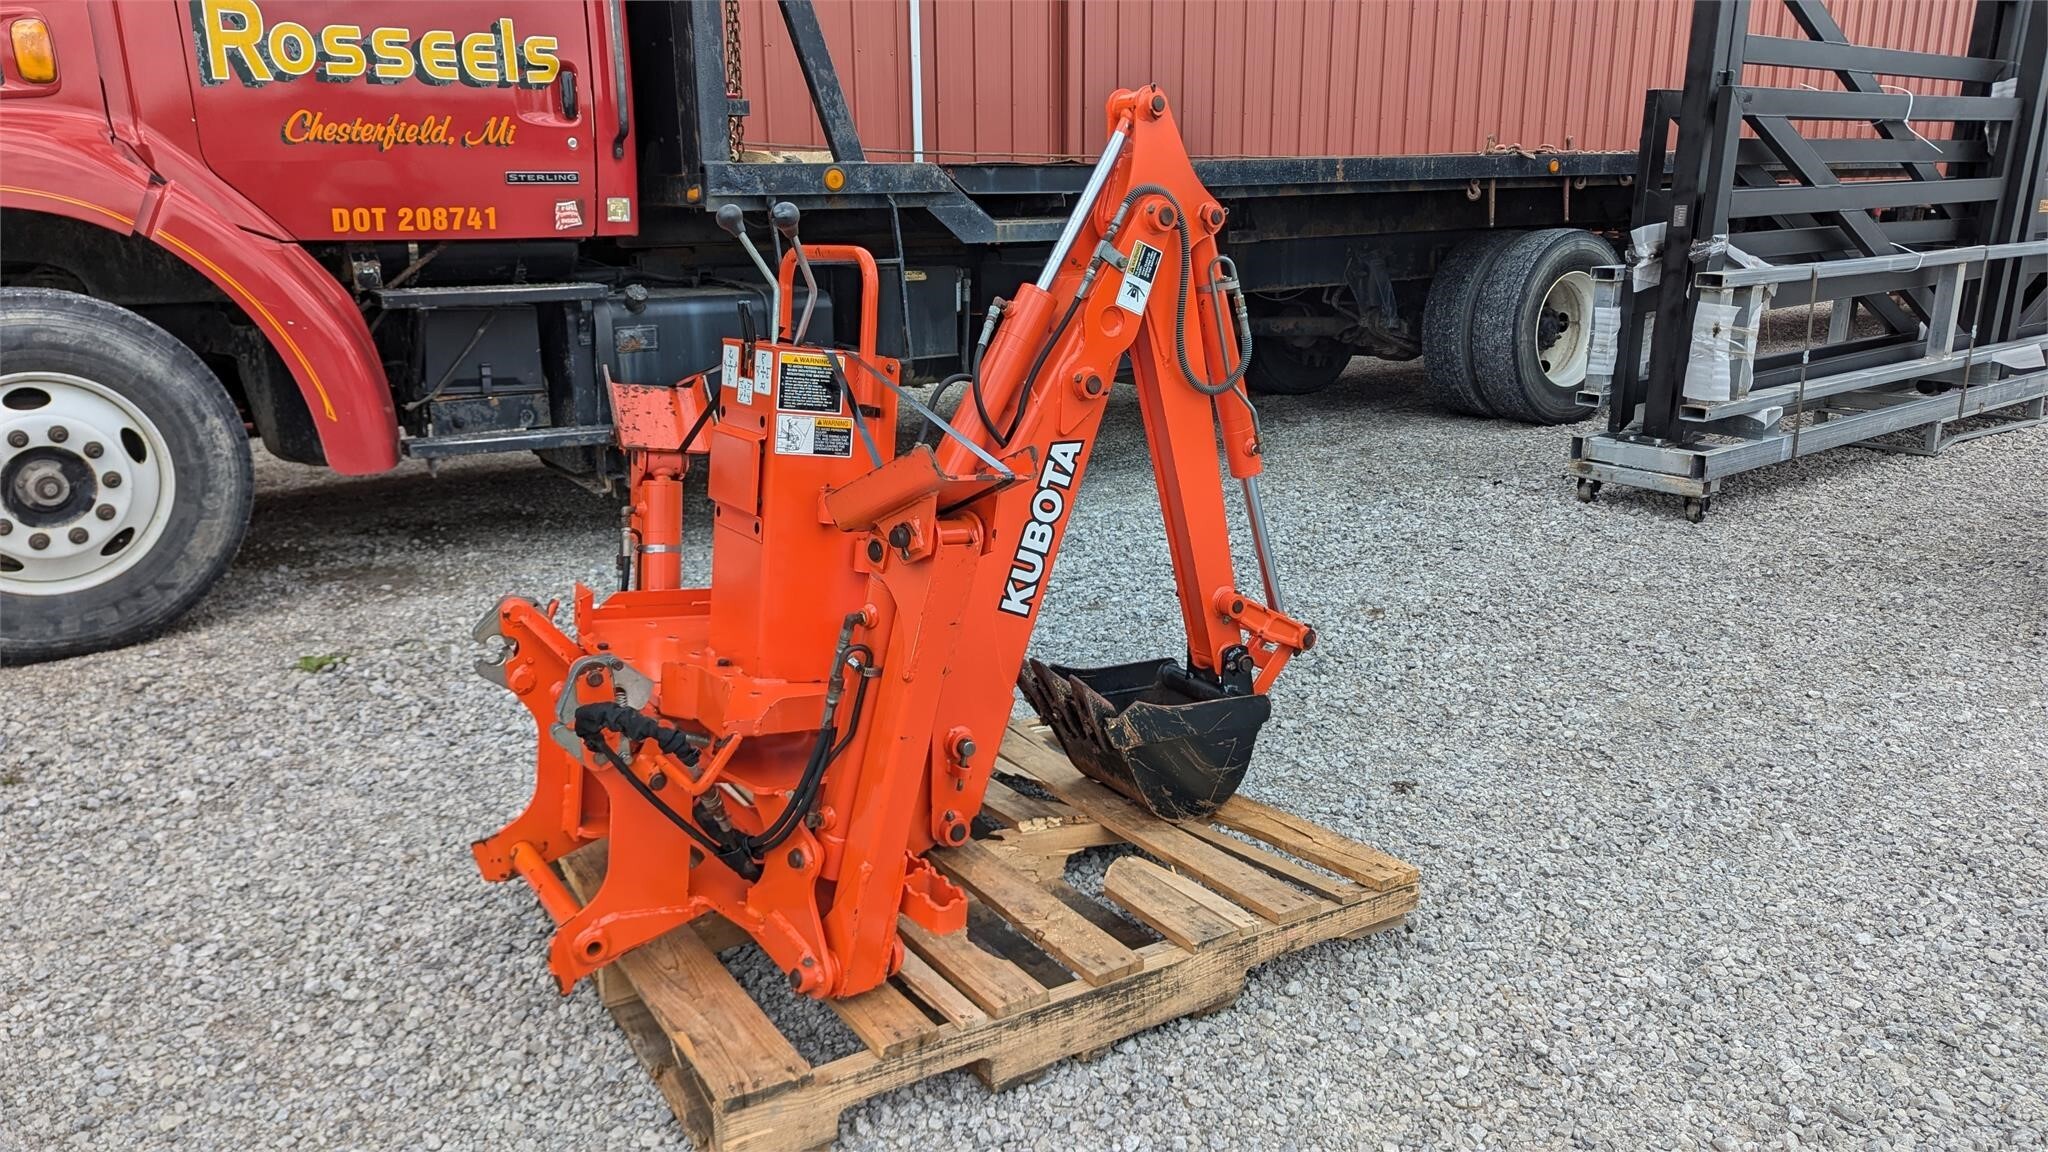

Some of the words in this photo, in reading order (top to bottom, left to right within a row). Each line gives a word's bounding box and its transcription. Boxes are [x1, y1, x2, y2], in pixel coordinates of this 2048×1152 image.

[199, 0, 560, 85] Rosseels
[283, 109, 455, 150] Chesterfield,
[463, 116, 517, 146] Mi
[508, 173, 578, 182] STERLING
[331, 207, 387, 233] DOT
[398, 206, 497, 232] 208741
[823, 419, 849, 427] WARNING
[999, 440, 1085, 618] KUBOTA
